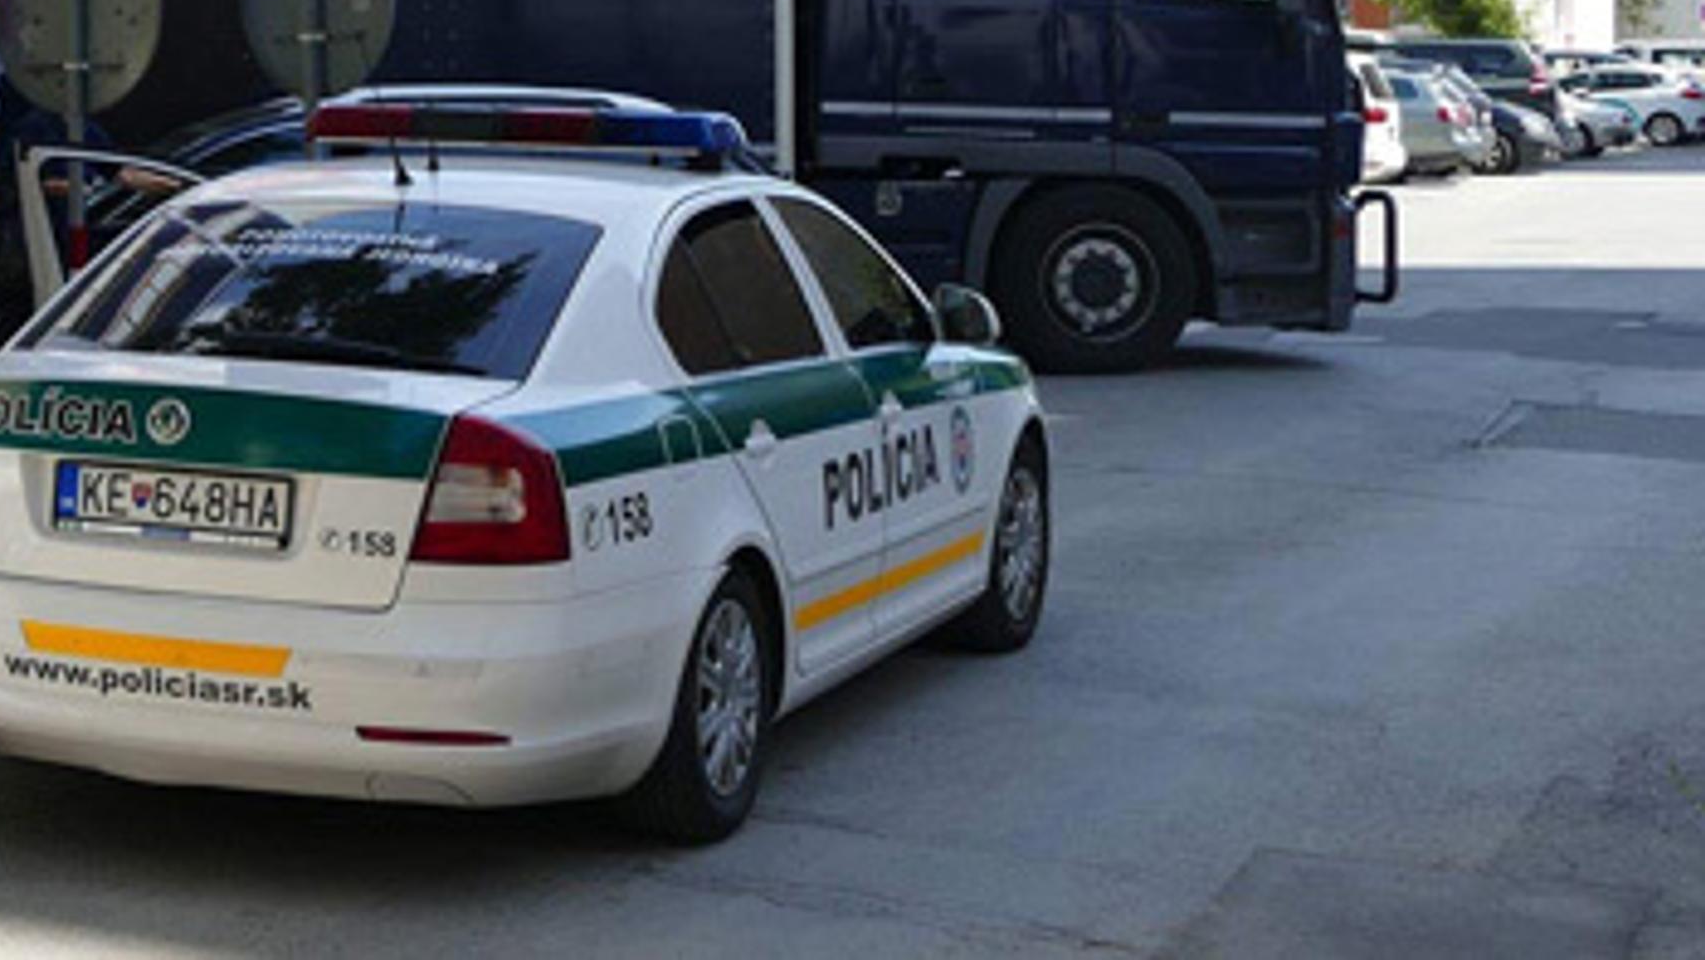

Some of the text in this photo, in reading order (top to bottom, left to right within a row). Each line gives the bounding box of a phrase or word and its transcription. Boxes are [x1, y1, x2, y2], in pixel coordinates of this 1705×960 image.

[822, 422, 941, 530] POLÍCIA
[606, 490, 654, 543] 158
[349, 532, 395, 558] 158
[4, 652, 312, 711] www.policiasr.sk
